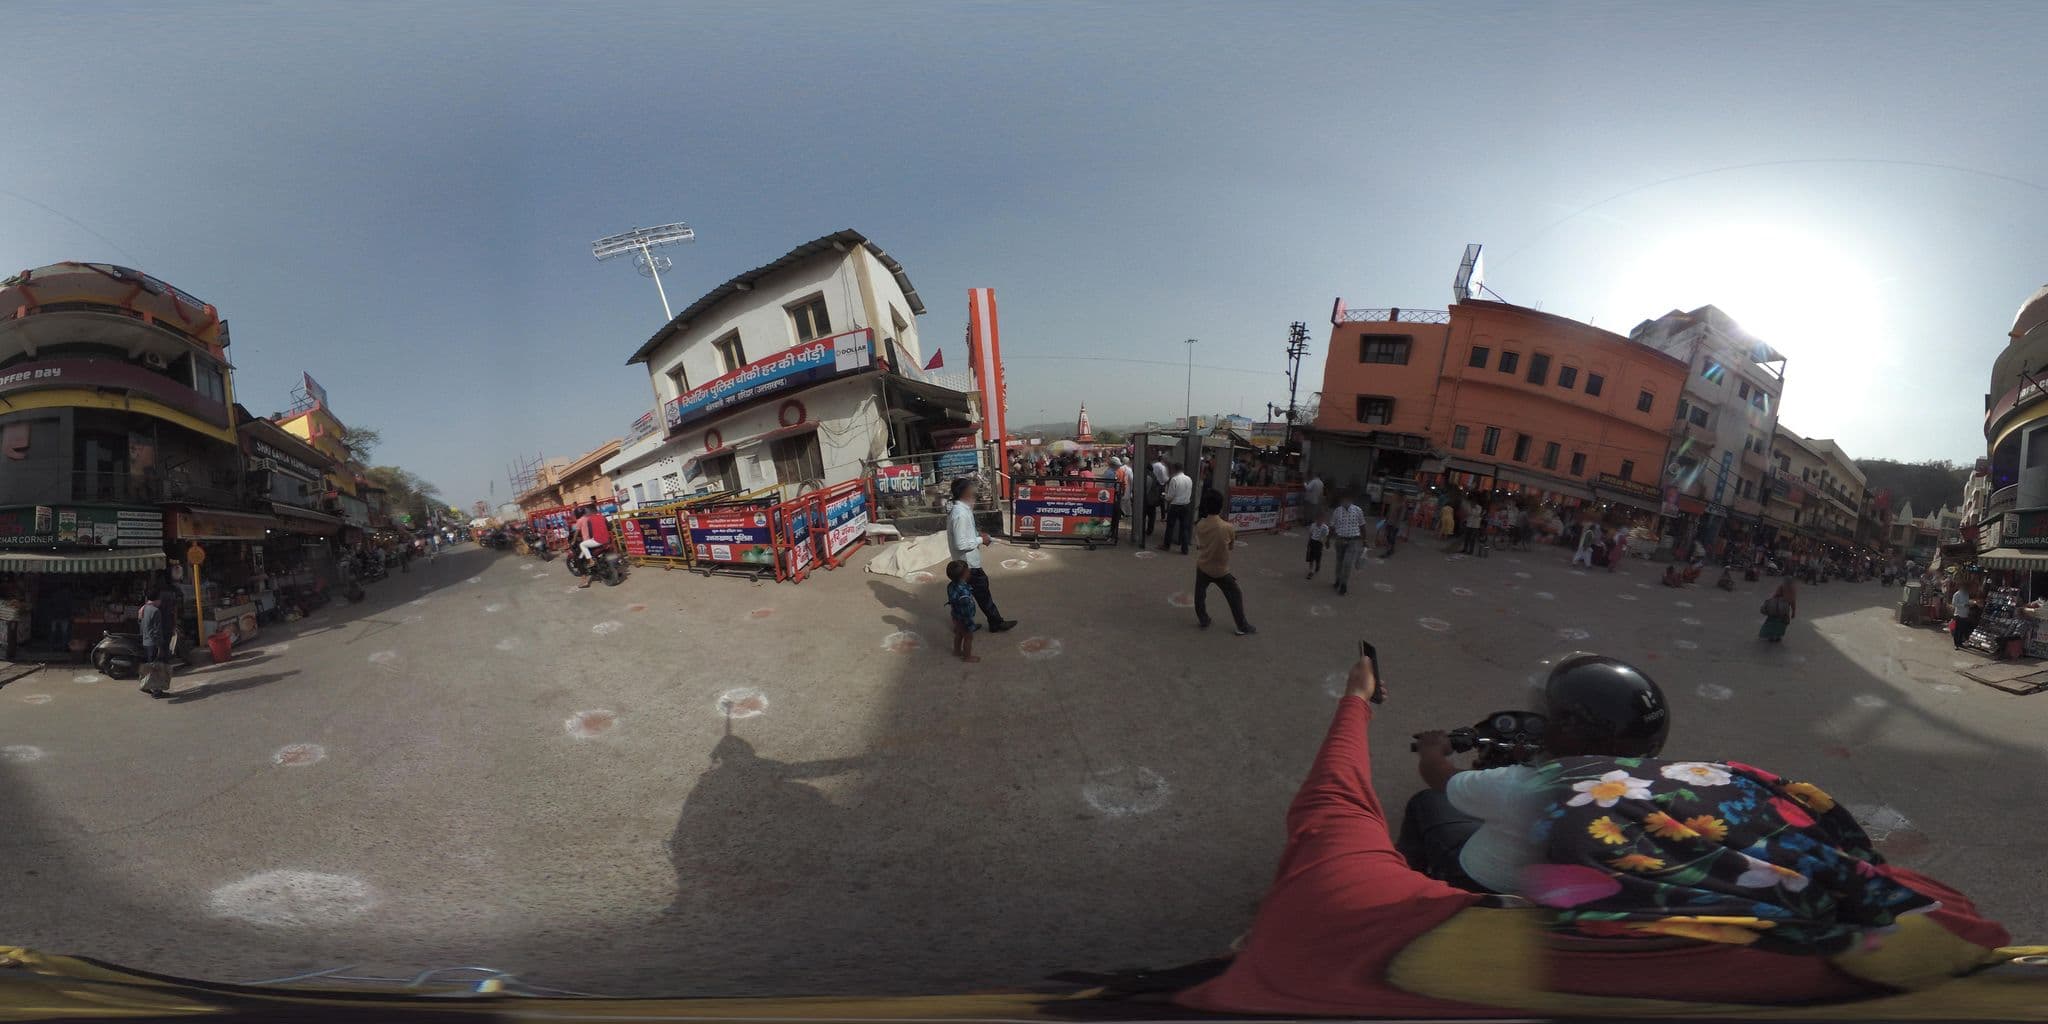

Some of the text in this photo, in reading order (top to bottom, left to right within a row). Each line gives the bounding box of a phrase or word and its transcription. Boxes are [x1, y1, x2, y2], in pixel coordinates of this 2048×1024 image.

[841, 345, 867, 355] DOLLAR
[779, 352, 796, 370] की
[18, 535, 55, 544] CORNER
